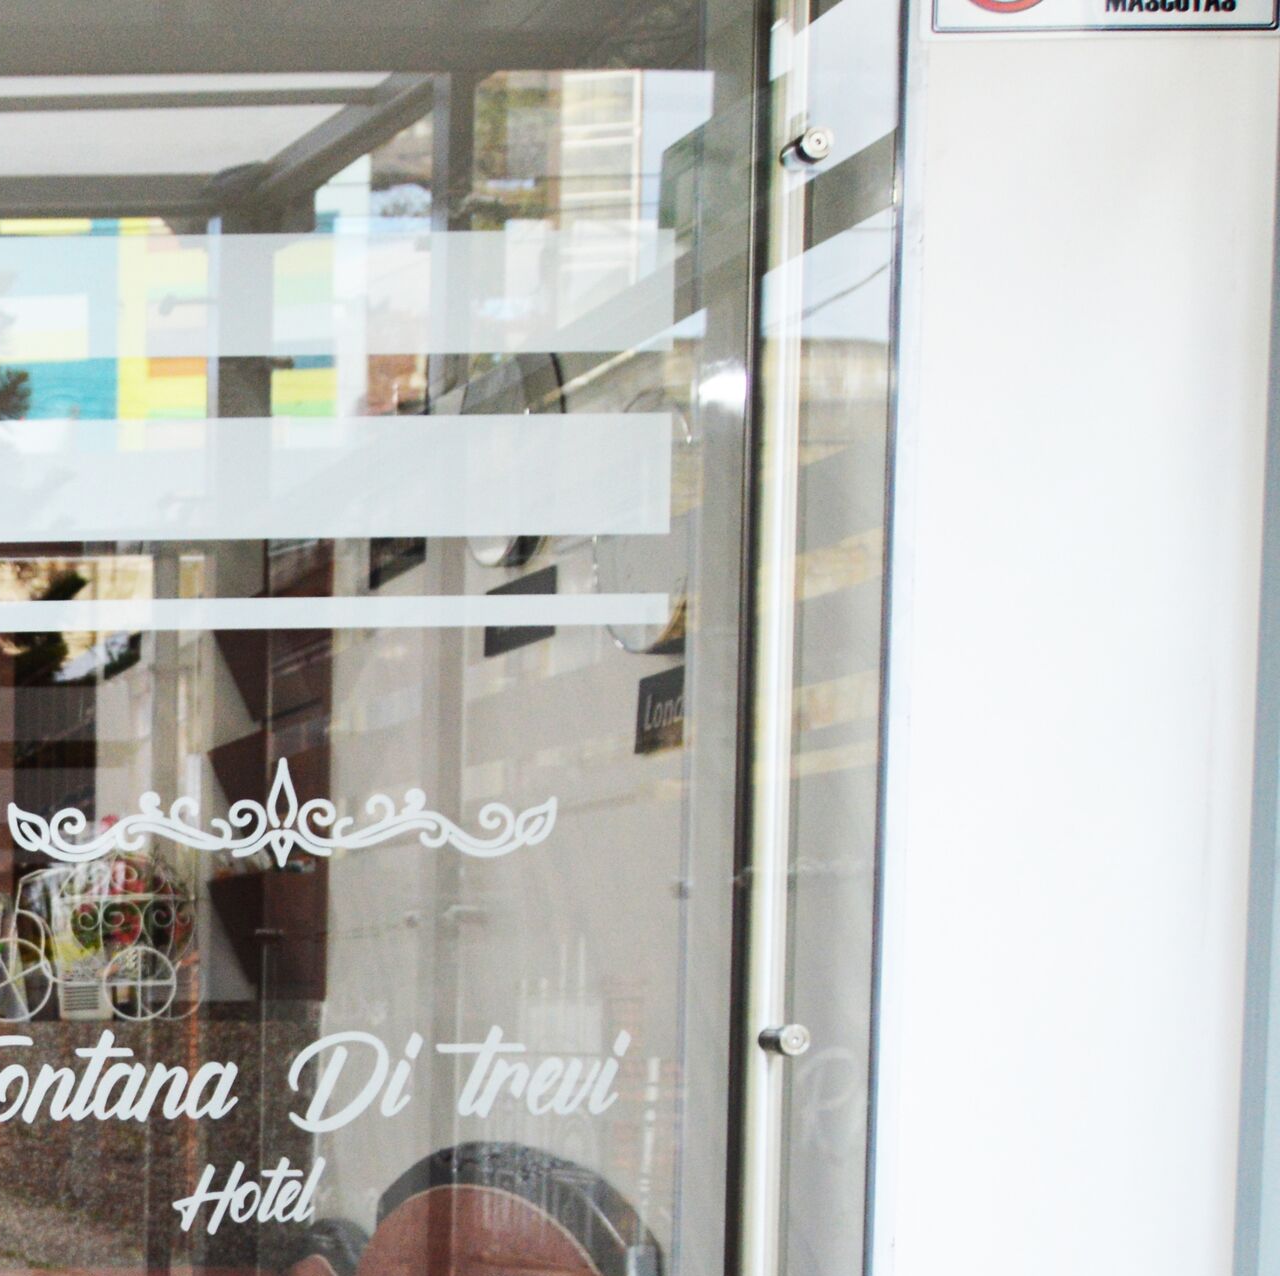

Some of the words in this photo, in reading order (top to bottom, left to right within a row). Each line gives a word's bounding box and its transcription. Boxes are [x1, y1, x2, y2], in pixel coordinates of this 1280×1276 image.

[289, 1031, 423, 1133] Di
[436, 1025, 631, 1118] trevi
[172, 1156, 326, 1236] Hotel
